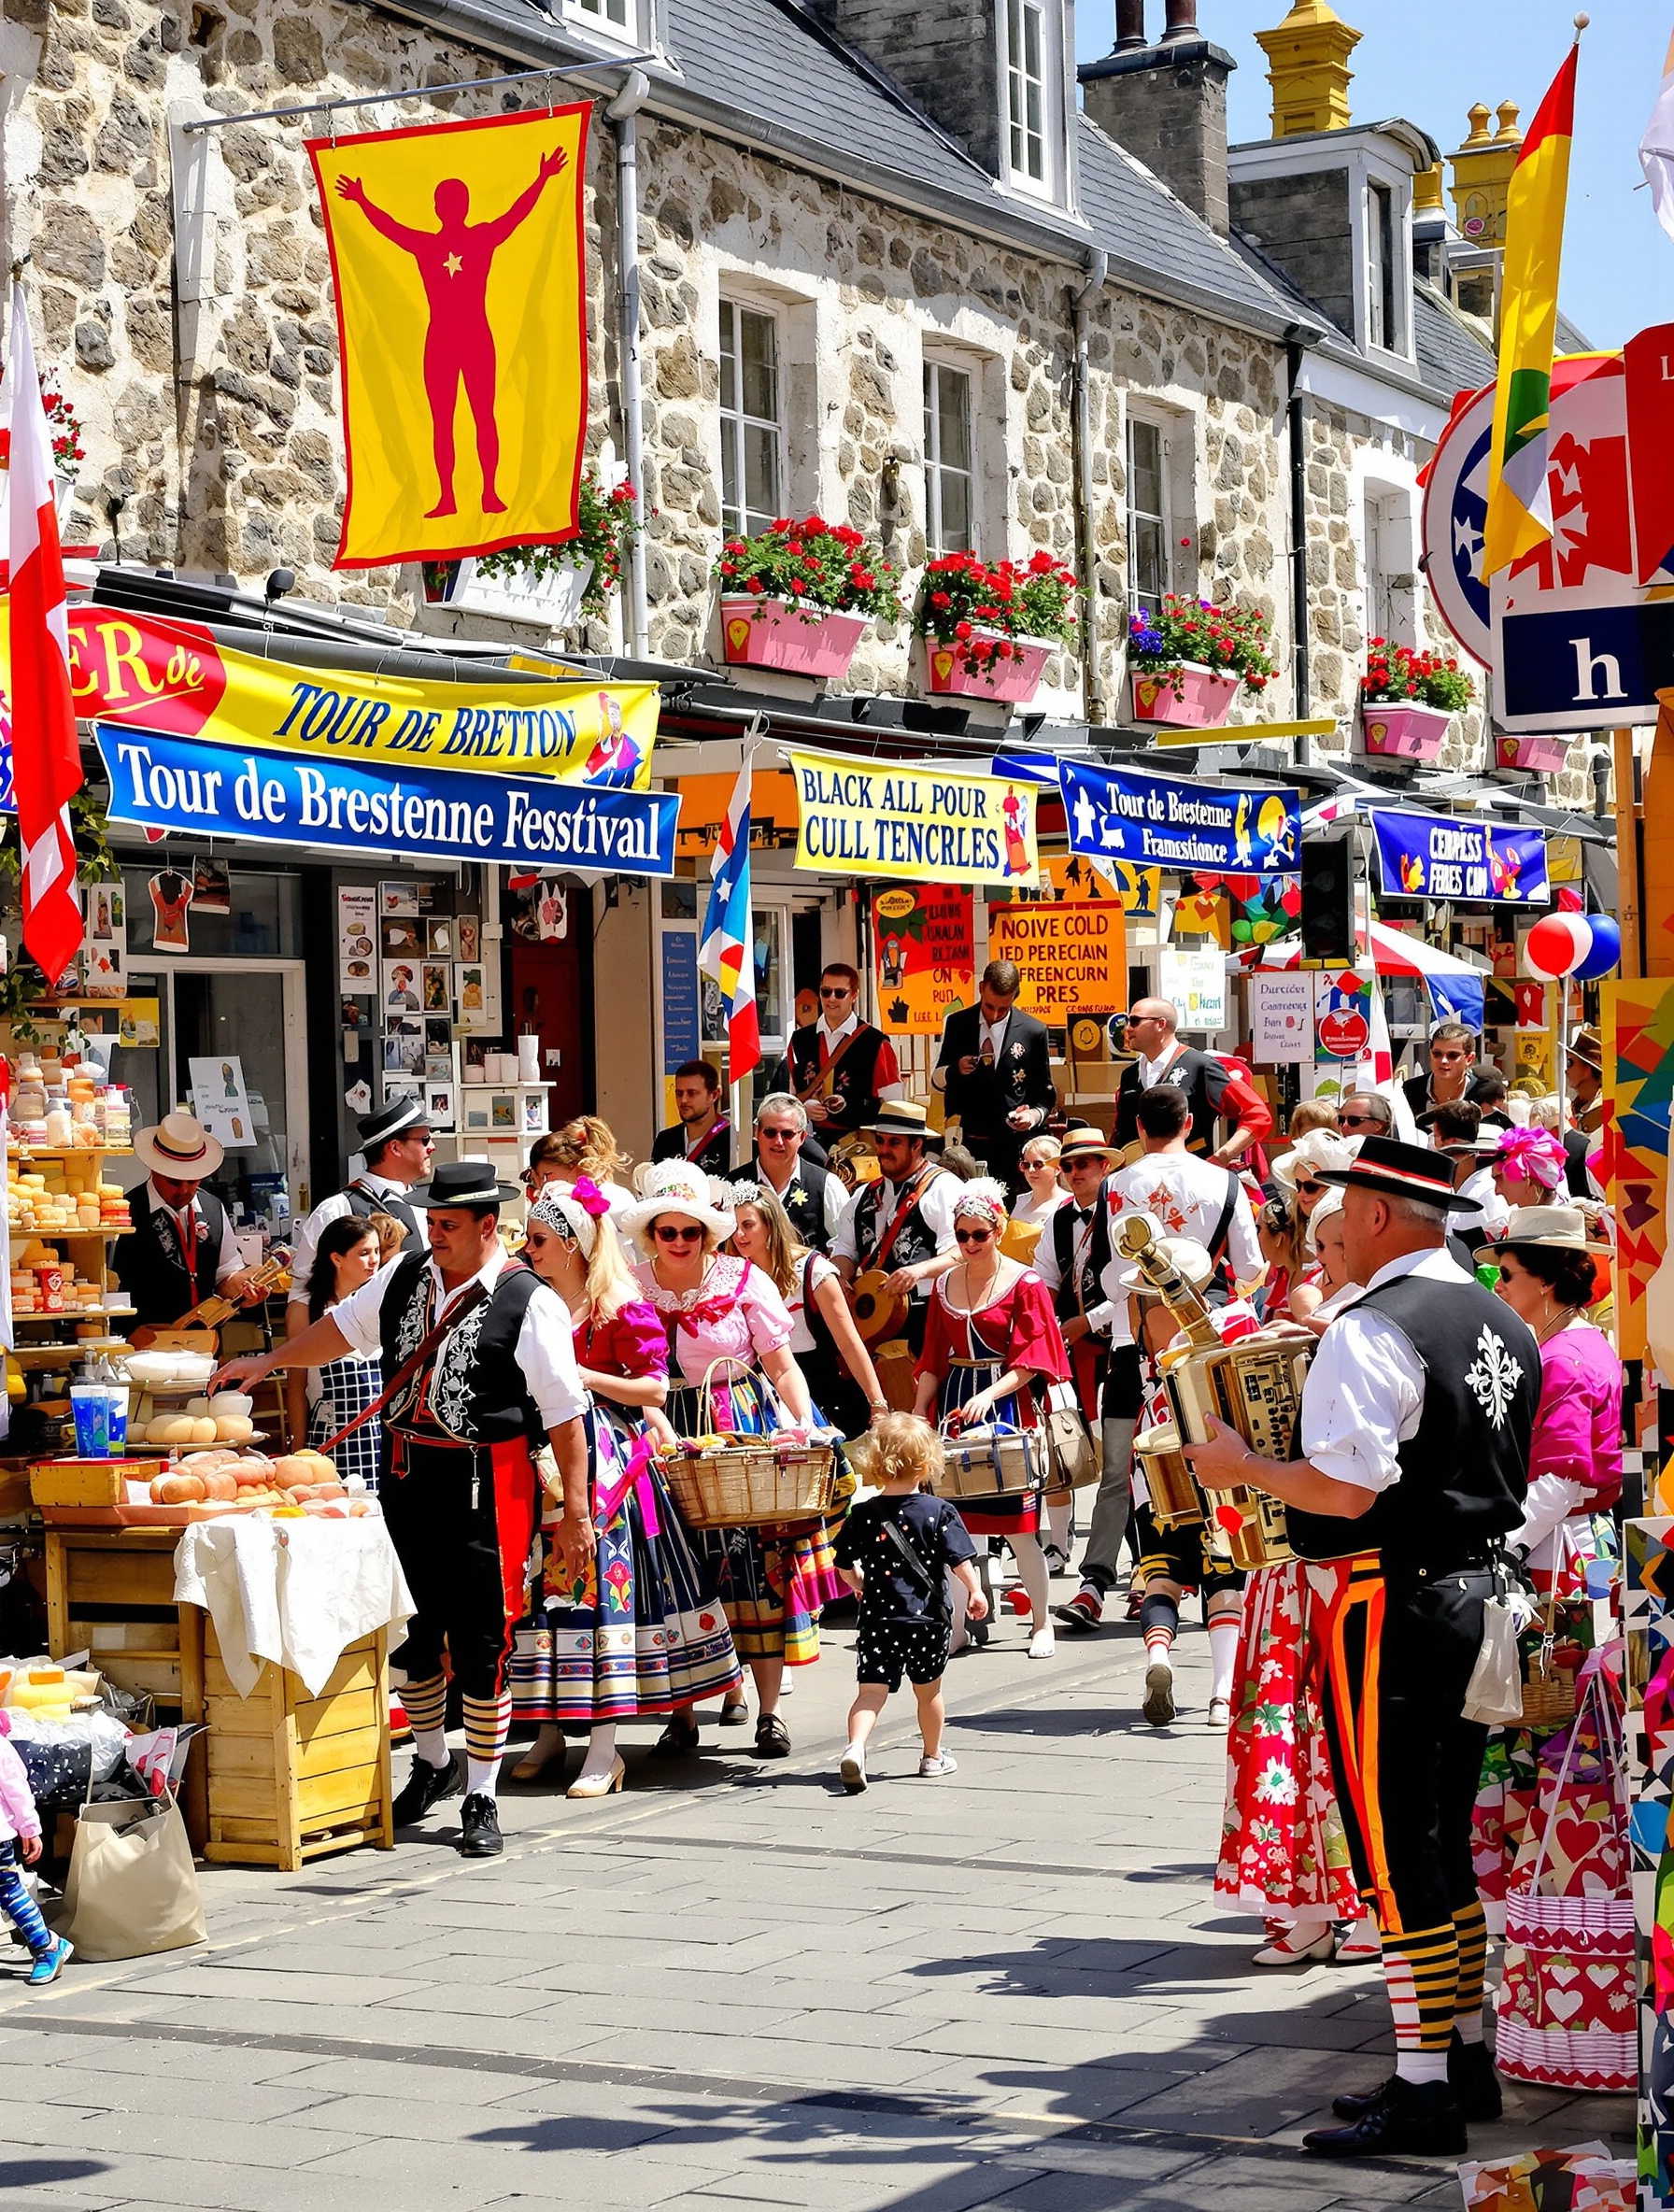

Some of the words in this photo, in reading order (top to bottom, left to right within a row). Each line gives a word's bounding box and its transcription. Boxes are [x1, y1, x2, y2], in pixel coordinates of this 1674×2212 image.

[1568, 637, 1628, 701] h
[273, 682, 390, 748] TOUR
[384, 710, 442, 753] DE
[439, 707, 576, 758] BRETTON
[117, 743, 223, 815] Tour
[234, 758, 287, 824] de
[293, 766, 494, 847] Brestenne
[802, 768, 874, 809] BLACK
[880, 778, 924, 815] ALL
[929, 783, 988, 819] POUR
[1106, 782, 1145, 818] Tour
[1147, 788, 1165, 821] de
[805, 815, 870, 860] CULL
[874, 818, 1000, 870] TENCRLES
[1001, 918, 1059, 940] NOIVE
[1064, 915, 1109, 936] COLD
[1019, 967, 1064, 983] FREEN
[1065, 967, 1109, 982] CURN
[1036, 985, 1080, 1004] PRES
